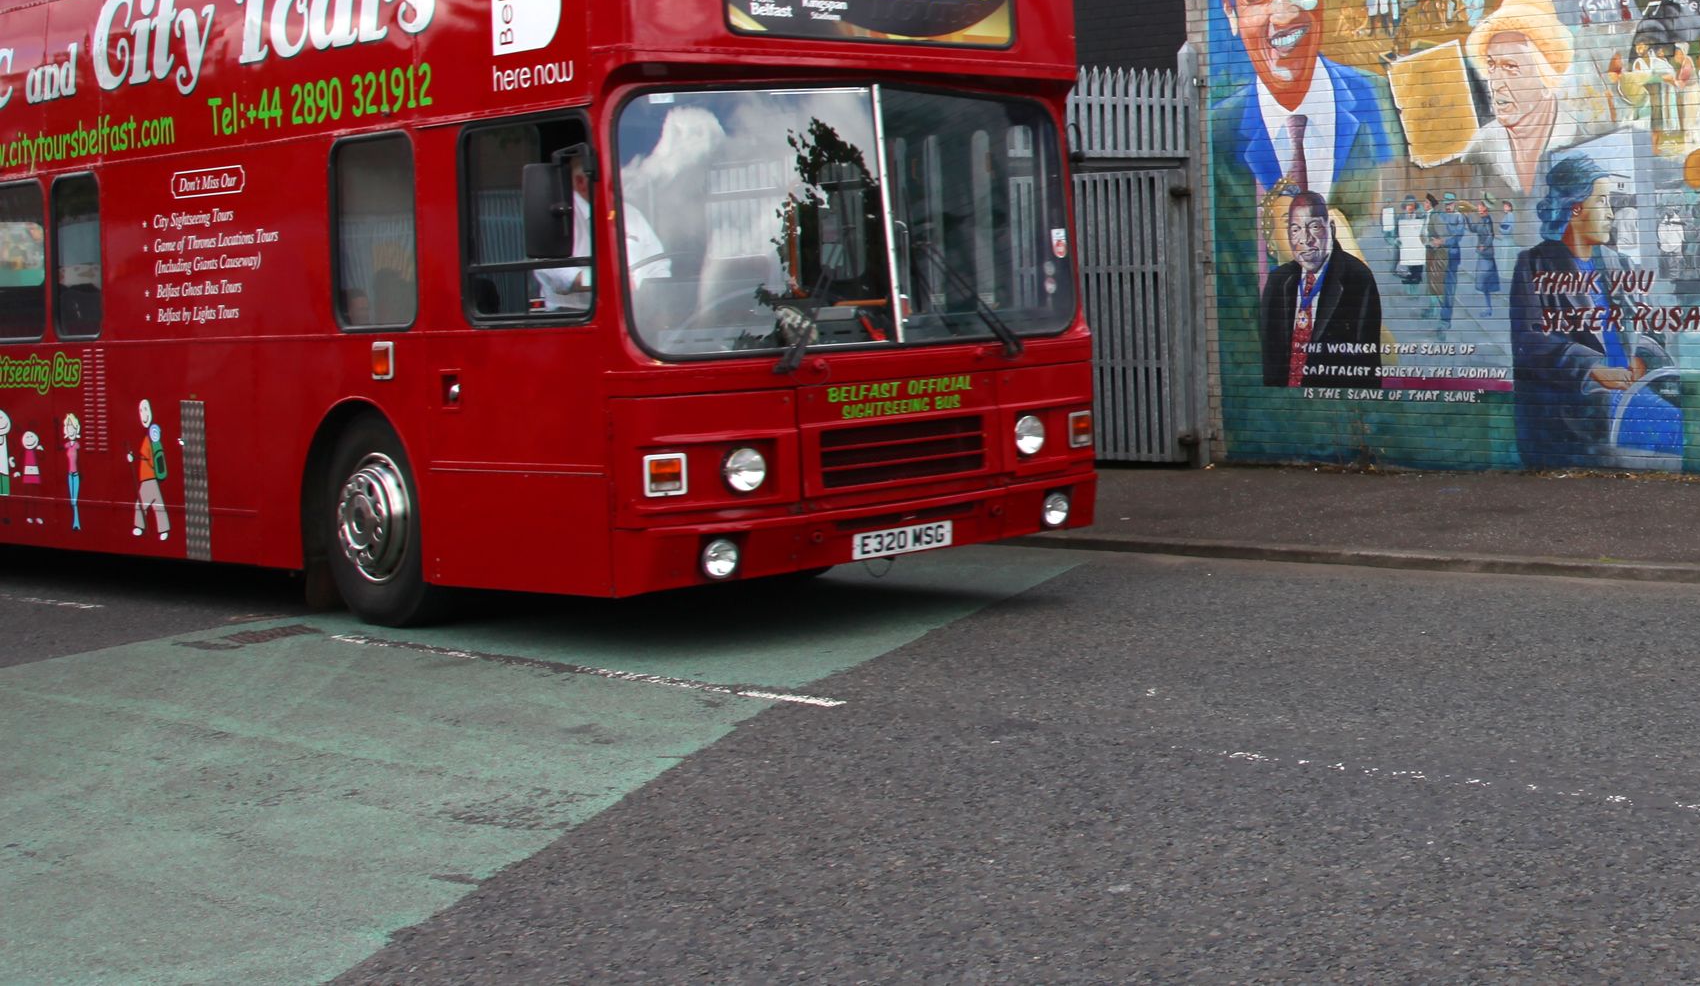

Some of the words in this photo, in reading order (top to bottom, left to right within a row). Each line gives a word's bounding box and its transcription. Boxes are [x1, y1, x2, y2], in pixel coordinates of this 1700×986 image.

[750, 3, 792, 18] Belfast
[26, 42, 77, 104] and
[493, 65, 531, 91] here
[534, 61, 573, 86] now
[291, 77, 342, 124] 2890
[351, 63, 432, 117] 321912
[179, 177, 200, 192] Don't
[202, 175, 219, 190] Miss
[221, 173, 237, 187] Our
[154, 215, 169, 231] City
[171, 210, 211, 230] Sightseeing
[212, 208, 233, 223] Tours
[155, 238, 175, 252] Game
[177, 236, 185, 254] of
[188, 235, 216, 250] Thrones
[218, 231, 254, 247] Locations
[256, 229, 278, 243] Tours
[194, 256, 217, 271] Giants
[157, 284, 180, 301] Belfast
[182, 282, 203, 297] Ghost
[205, 281, 218, 295] Bus
[221, 280, 242, 294] Tours
[1533, 271, 1602, 295] THANK
[1609, 270, 1655, 296] YOU
[158, 308, 181, 325] Belfast
[193, 306, 216, 324] Lights
[218, 305, 239, 319] Tours
[1542, 306, 1624, 334] SISTER
[1327, 343, 1376, 353] WORKER
[1381, 344, 1391, 354] IS
[1393, 344, 1416, 354] THE
[1420, 344, 1455, 354] SLAVE
[1460, 344, 1475, 355] OF
[54, 355, 80, 384] Bus
[1302, 365, 1370, 376] CAPITALIST
[1428, 367, 1450, 377] THE
[828, 382, 901, 402] BELFAST
[908, 376, 973, 394] OFFICIAL
[1304, 389, 1313, 398] IS
[1319, 389, 1341, 399] THE
[1347, 389, 1384, 400] SLAVE
[1389, 390, 1402, 401] OF
[1408, 391, 1439, 401] THAT
[842, 398, 930, 419] SIGHTSEEING
[935, 394, 960, 409] BUS
[861, 530, 907, 555] E320
[911, 525, 945, 546] MSG
